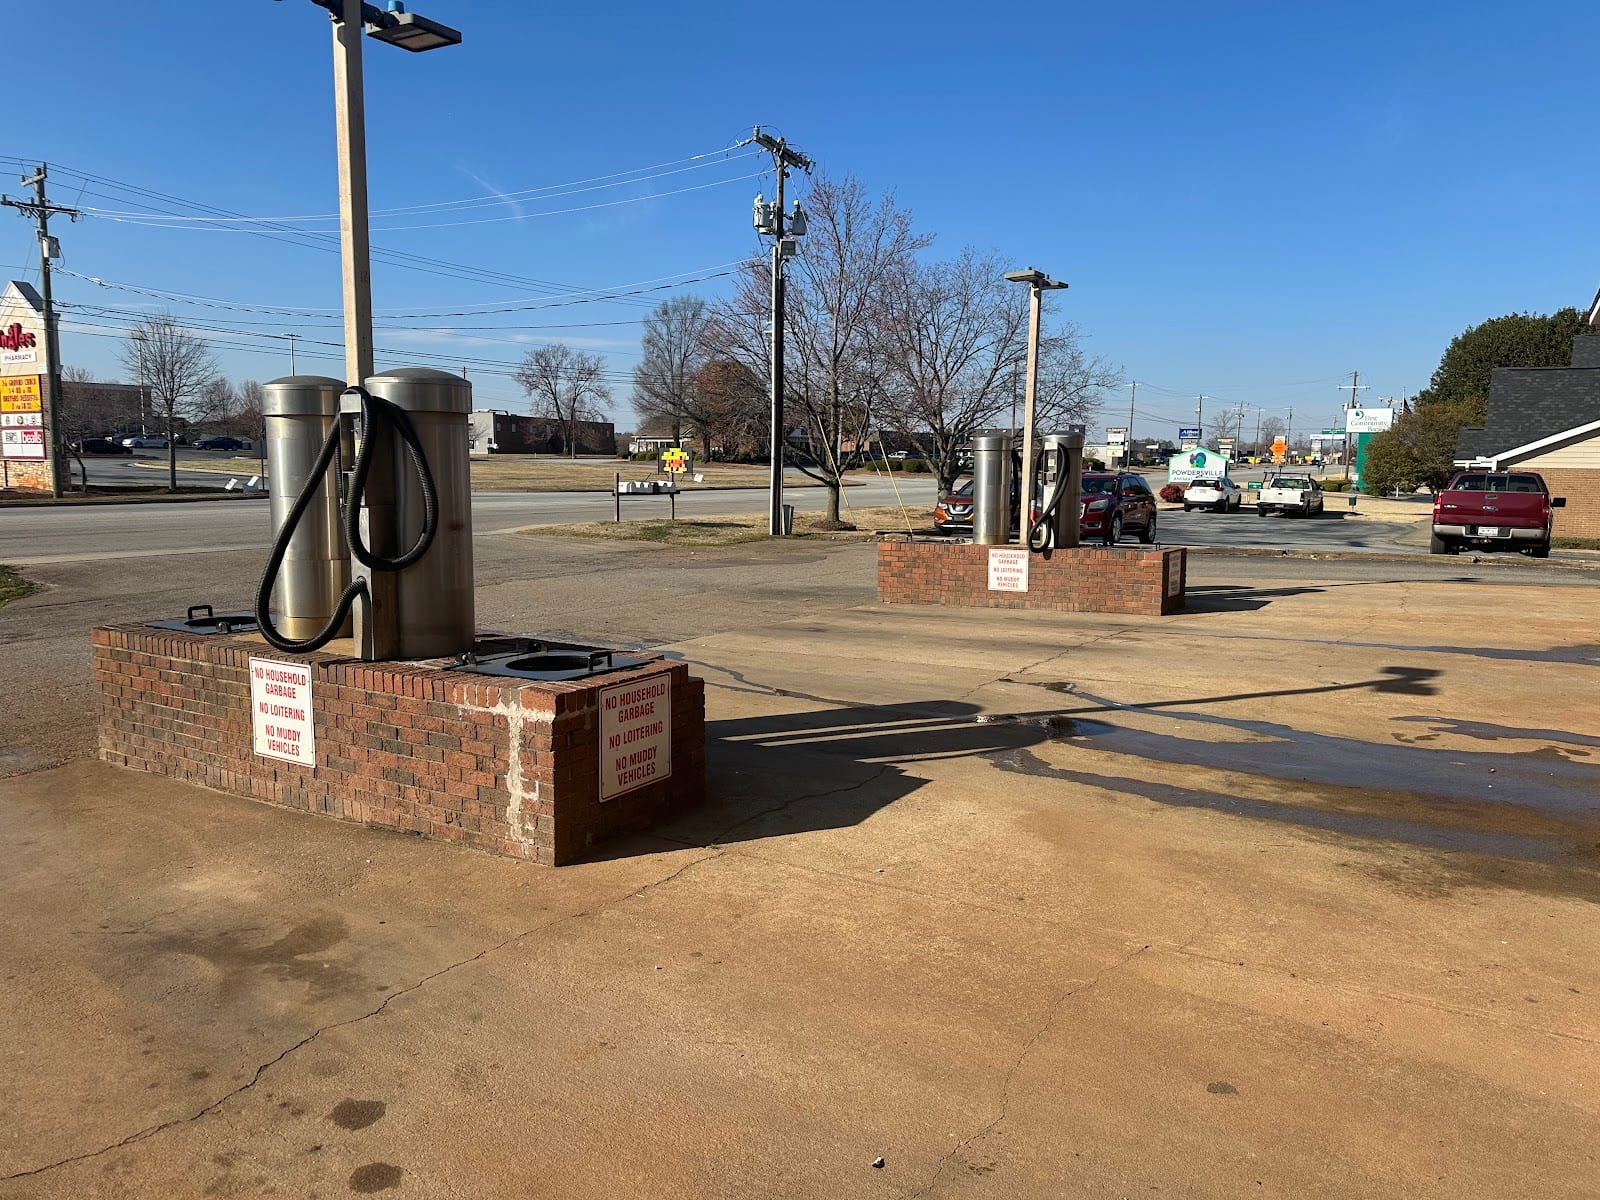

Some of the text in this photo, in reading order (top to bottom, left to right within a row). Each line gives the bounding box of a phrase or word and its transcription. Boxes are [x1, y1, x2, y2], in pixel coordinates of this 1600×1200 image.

[0, 323, 36, 351] ngles
[23, 431, 42, 444] bealls
[255, 667, 306, 686] NO HOUSEHOLD
[265, 683, 297, 699] GARBAGE
[605, 683, 665, 711] NO HOUSEHOLD
[260, 702, 305, 721] NO LOITERING
[618, 701, 655, 723] GARBAGE
[266, 724, 301, 743] NO MUDDY
[609, 721, 663, 750] NO LOITERING
[268, 739, 300, 757] VEHICLES
[616, 745, 658, 772] NO MUDDY
[618, 762, 656, 786] VEHICLES
